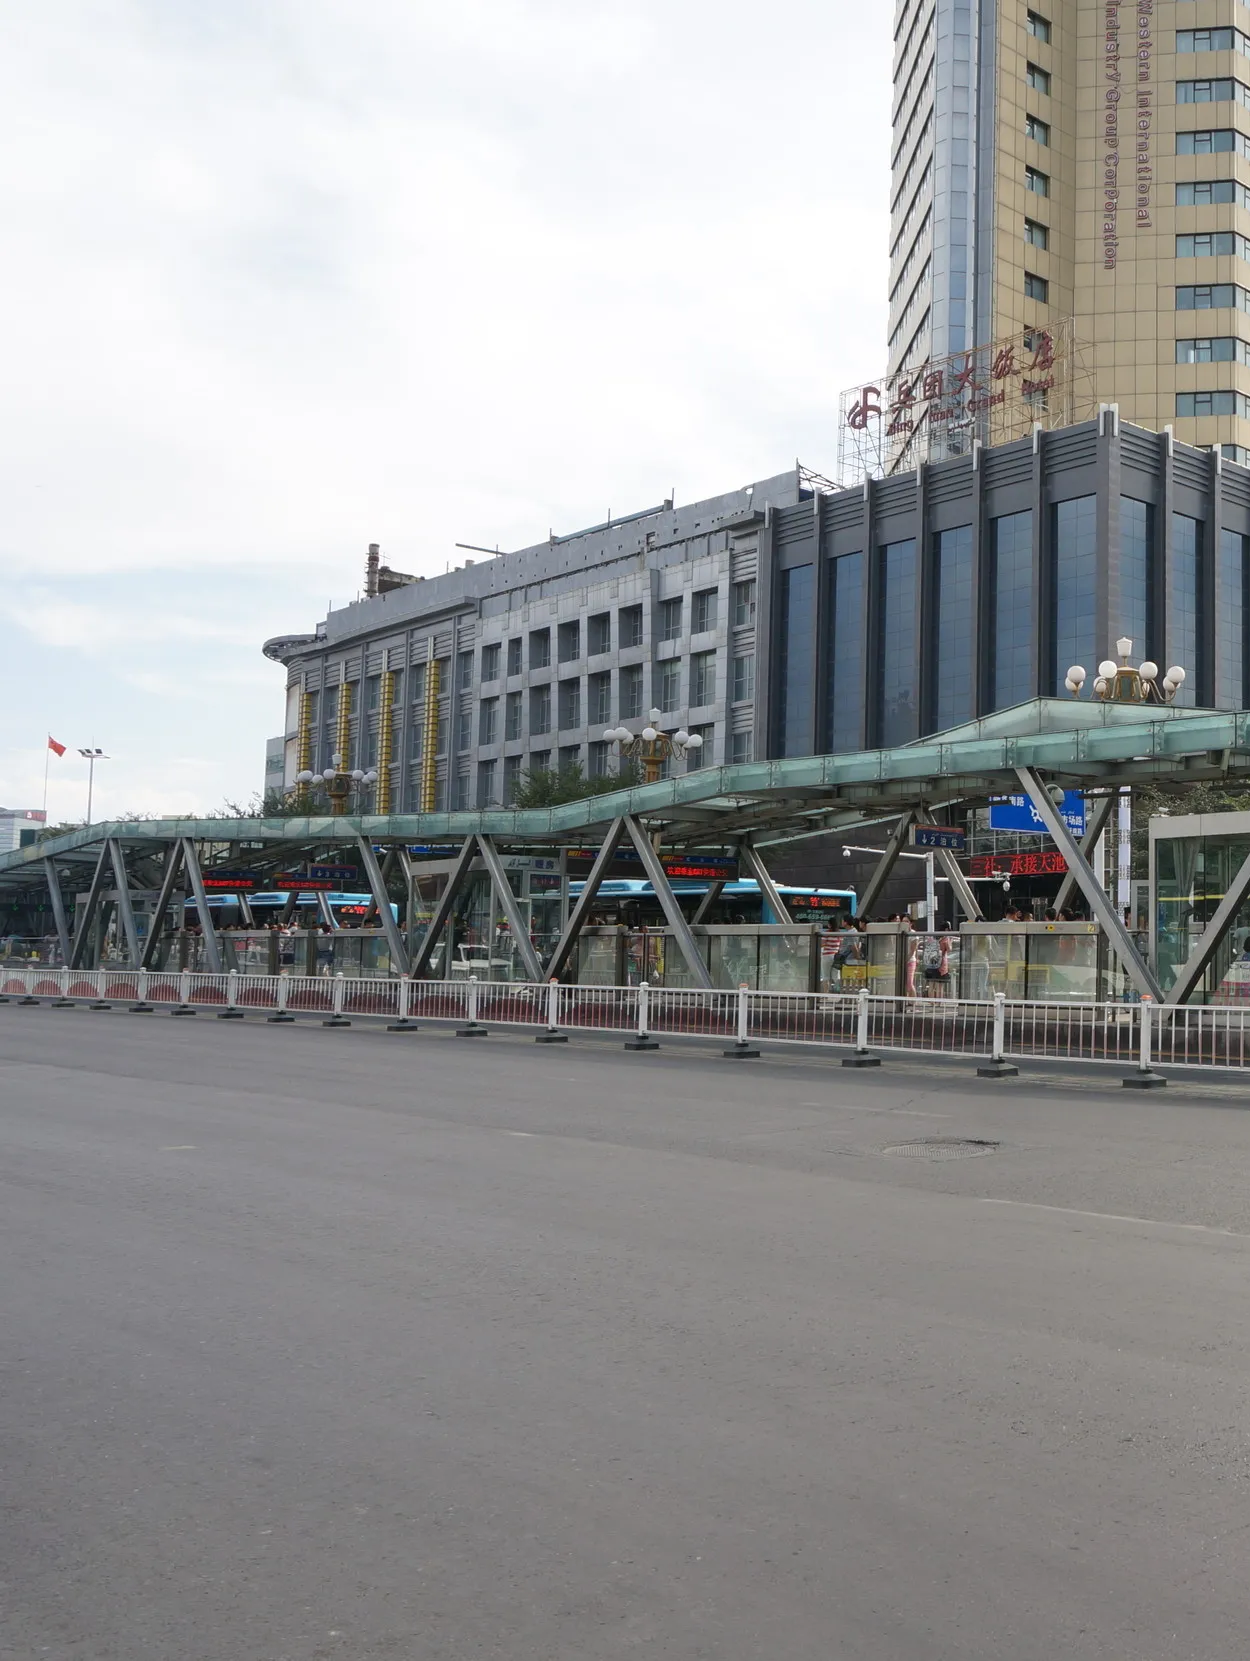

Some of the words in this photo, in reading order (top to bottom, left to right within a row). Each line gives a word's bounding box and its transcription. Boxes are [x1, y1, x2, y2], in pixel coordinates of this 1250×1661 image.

[1104, 0, 1121, 83] Industry
[1104, 88, 1121, 148] Group
[1136, 89, 1153, 228] International
[1103, 152, 1120, 270] Corporation
[890, 330, 1056, 417] 兵团大饭店
